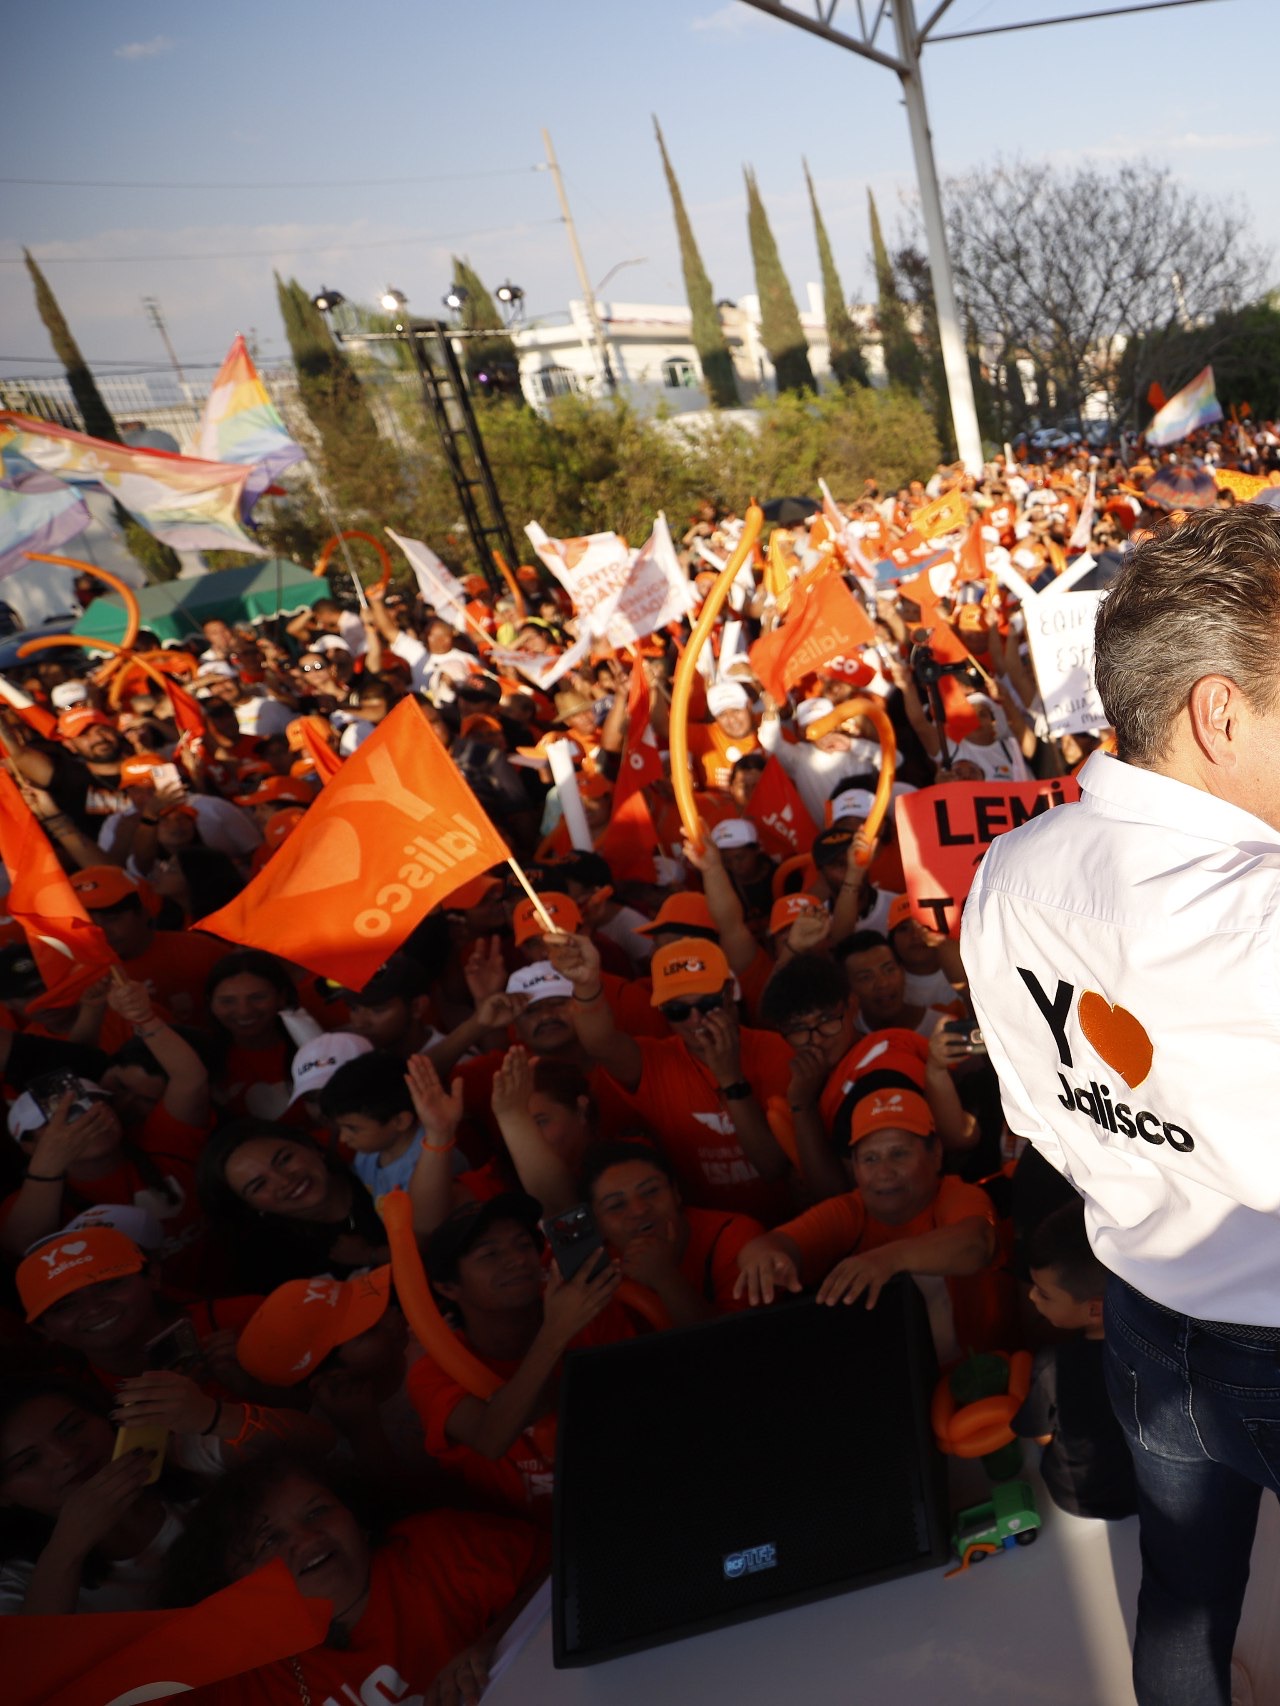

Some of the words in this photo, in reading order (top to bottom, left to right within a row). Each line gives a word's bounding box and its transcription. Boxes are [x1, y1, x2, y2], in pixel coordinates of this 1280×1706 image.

[1016, 966, 1074, 1068] Y
[1057, 1071, 1195, 1153] Jalisco
[40, 1248, 59, 1268] Y
[48, 1254, 95, 1280] Jalisco
